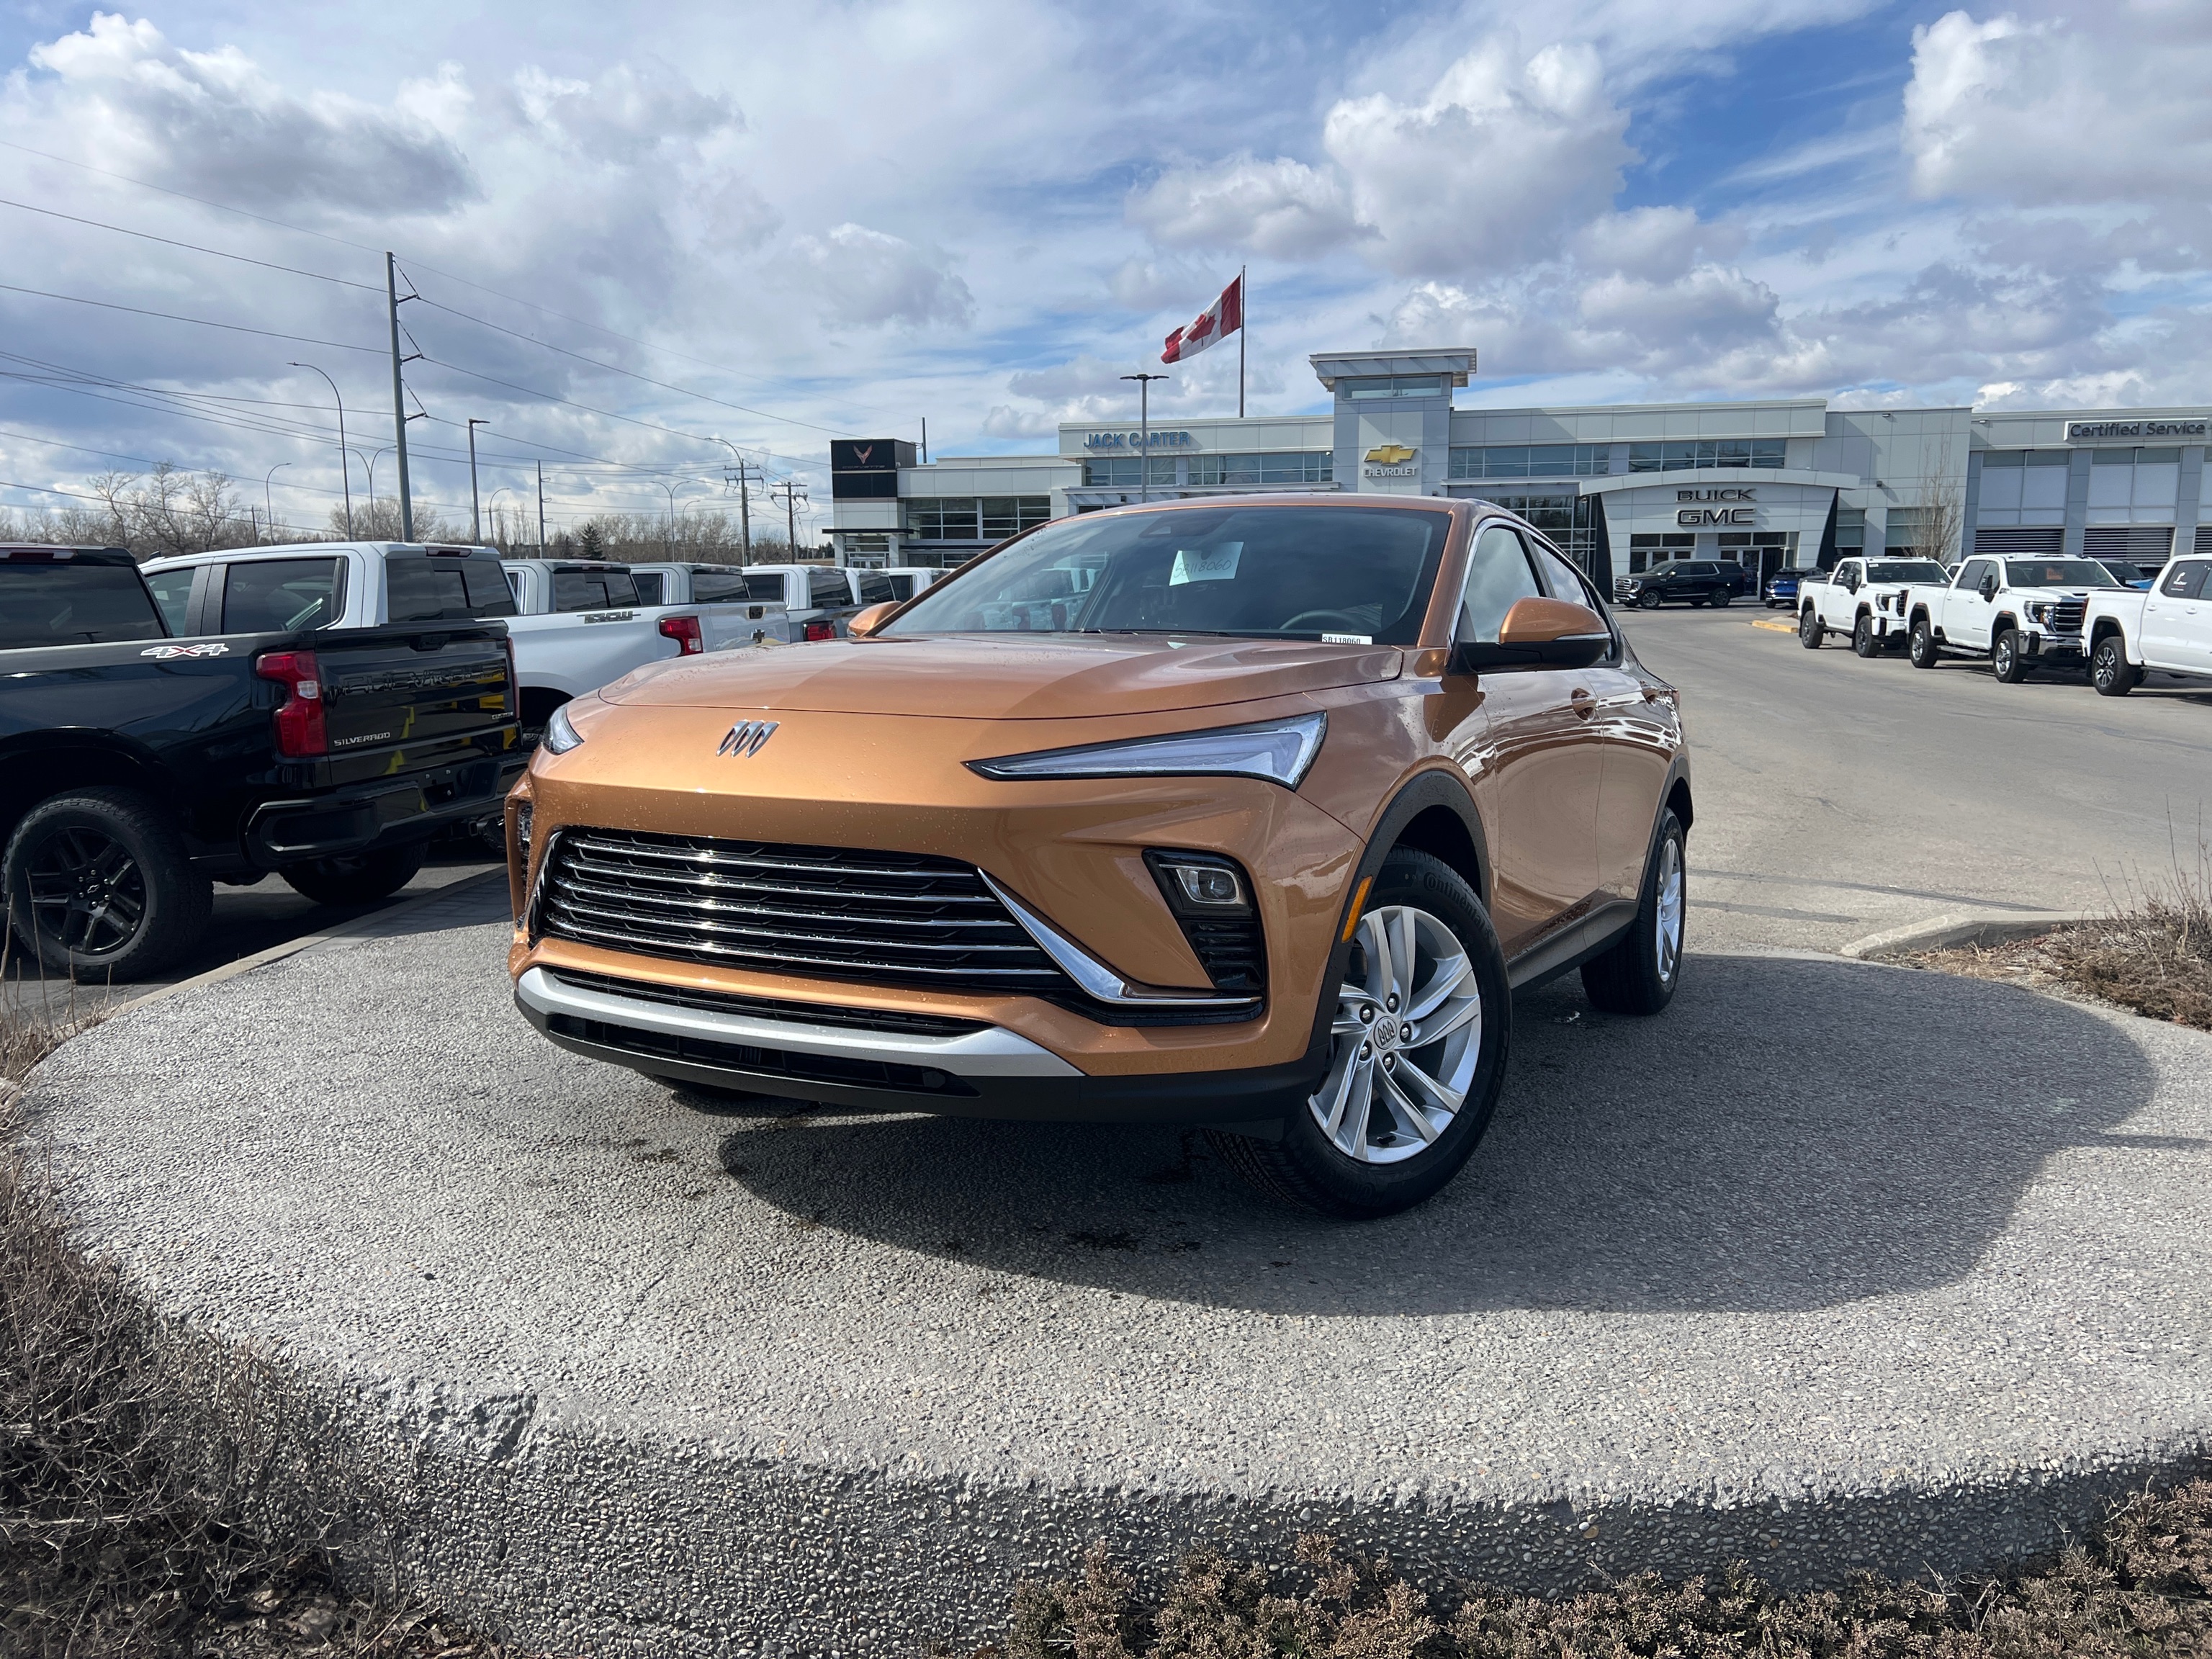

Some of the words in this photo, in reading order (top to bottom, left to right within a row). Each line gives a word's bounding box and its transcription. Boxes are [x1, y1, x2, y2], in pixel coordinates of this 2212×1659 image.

[2070, 423, 2140, 438] Certified
[2146, 421, 2206, 435] Service
[1084, 433, 1124, 448] JACK
[1364, 467, 1417, 477] CHEVROLET
[1676, 488, 1757, 503] BUICK
[1676, 508, 1756, 526] GMC
[334, 732, 390, 747] SILVERADO
